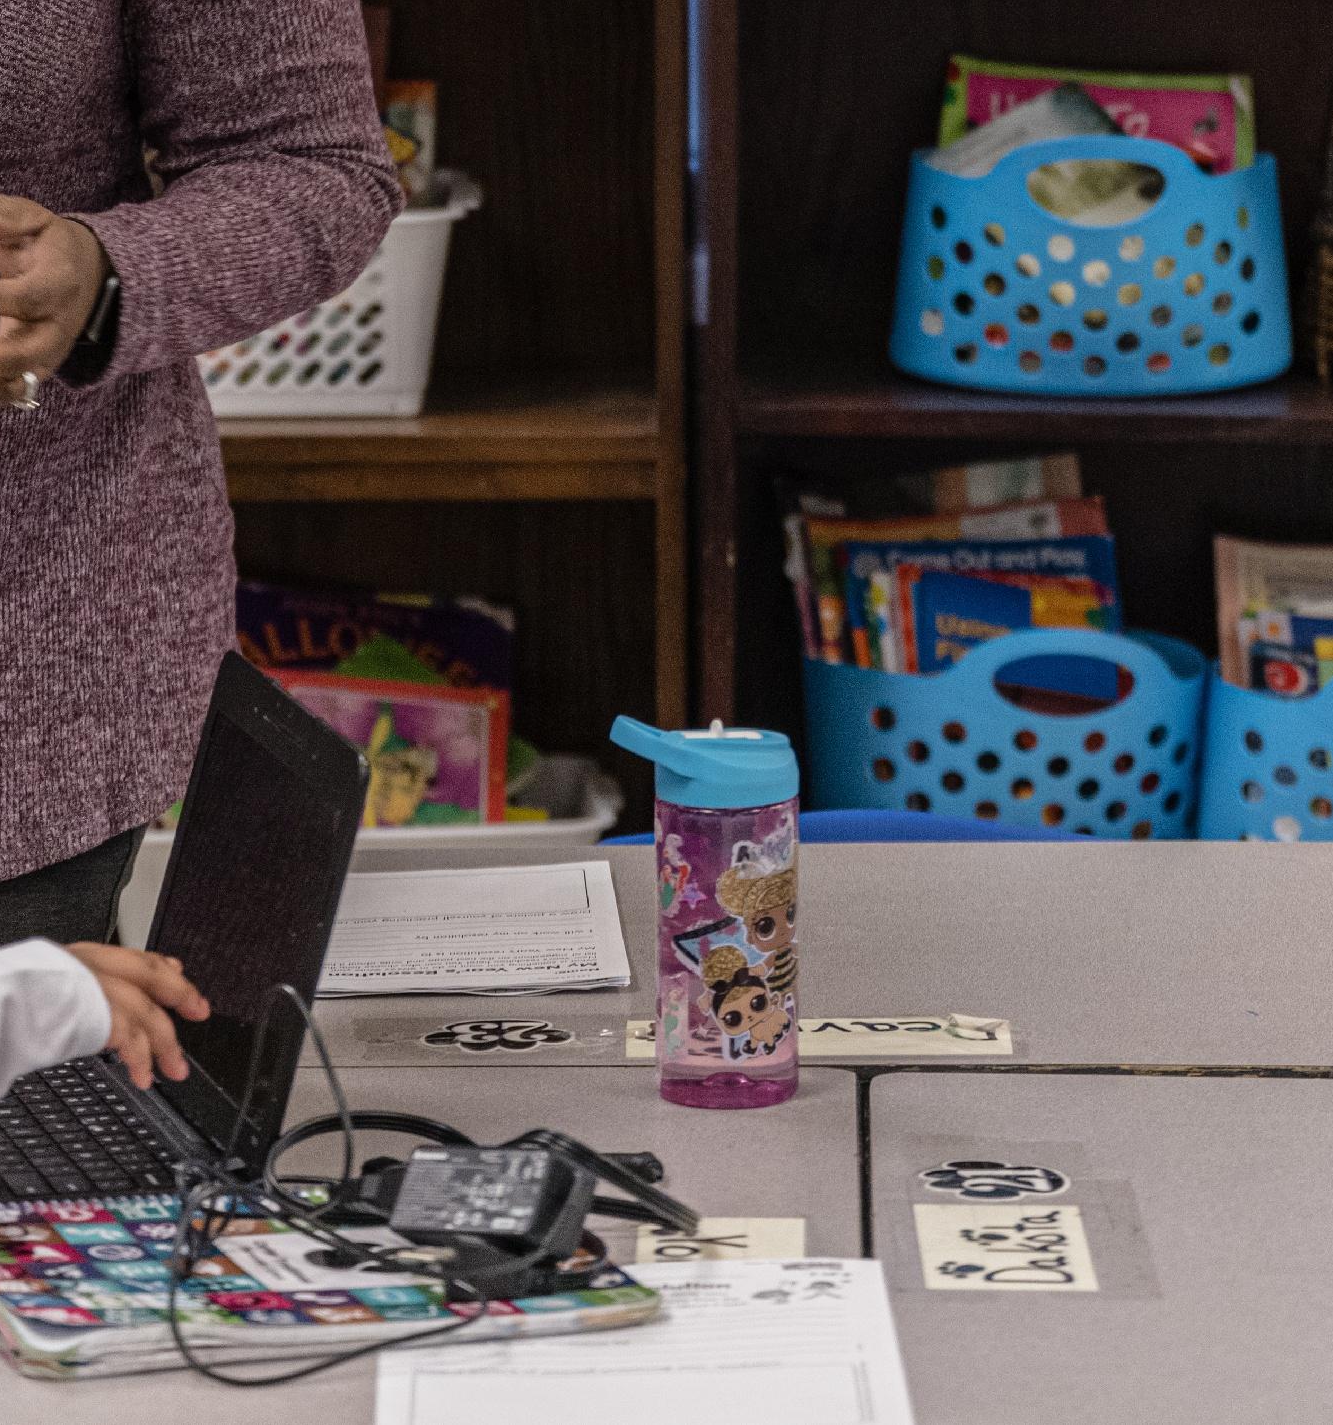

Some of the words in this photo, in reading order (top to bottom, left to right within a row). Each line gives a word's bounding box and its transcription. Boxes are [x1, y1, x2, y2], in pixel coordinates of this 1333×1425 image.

[450, 1021, 548, 1043] 23
[956, 1167, 1050, 1192] 21
[981, 1211, 1075, 1284] Dakota
